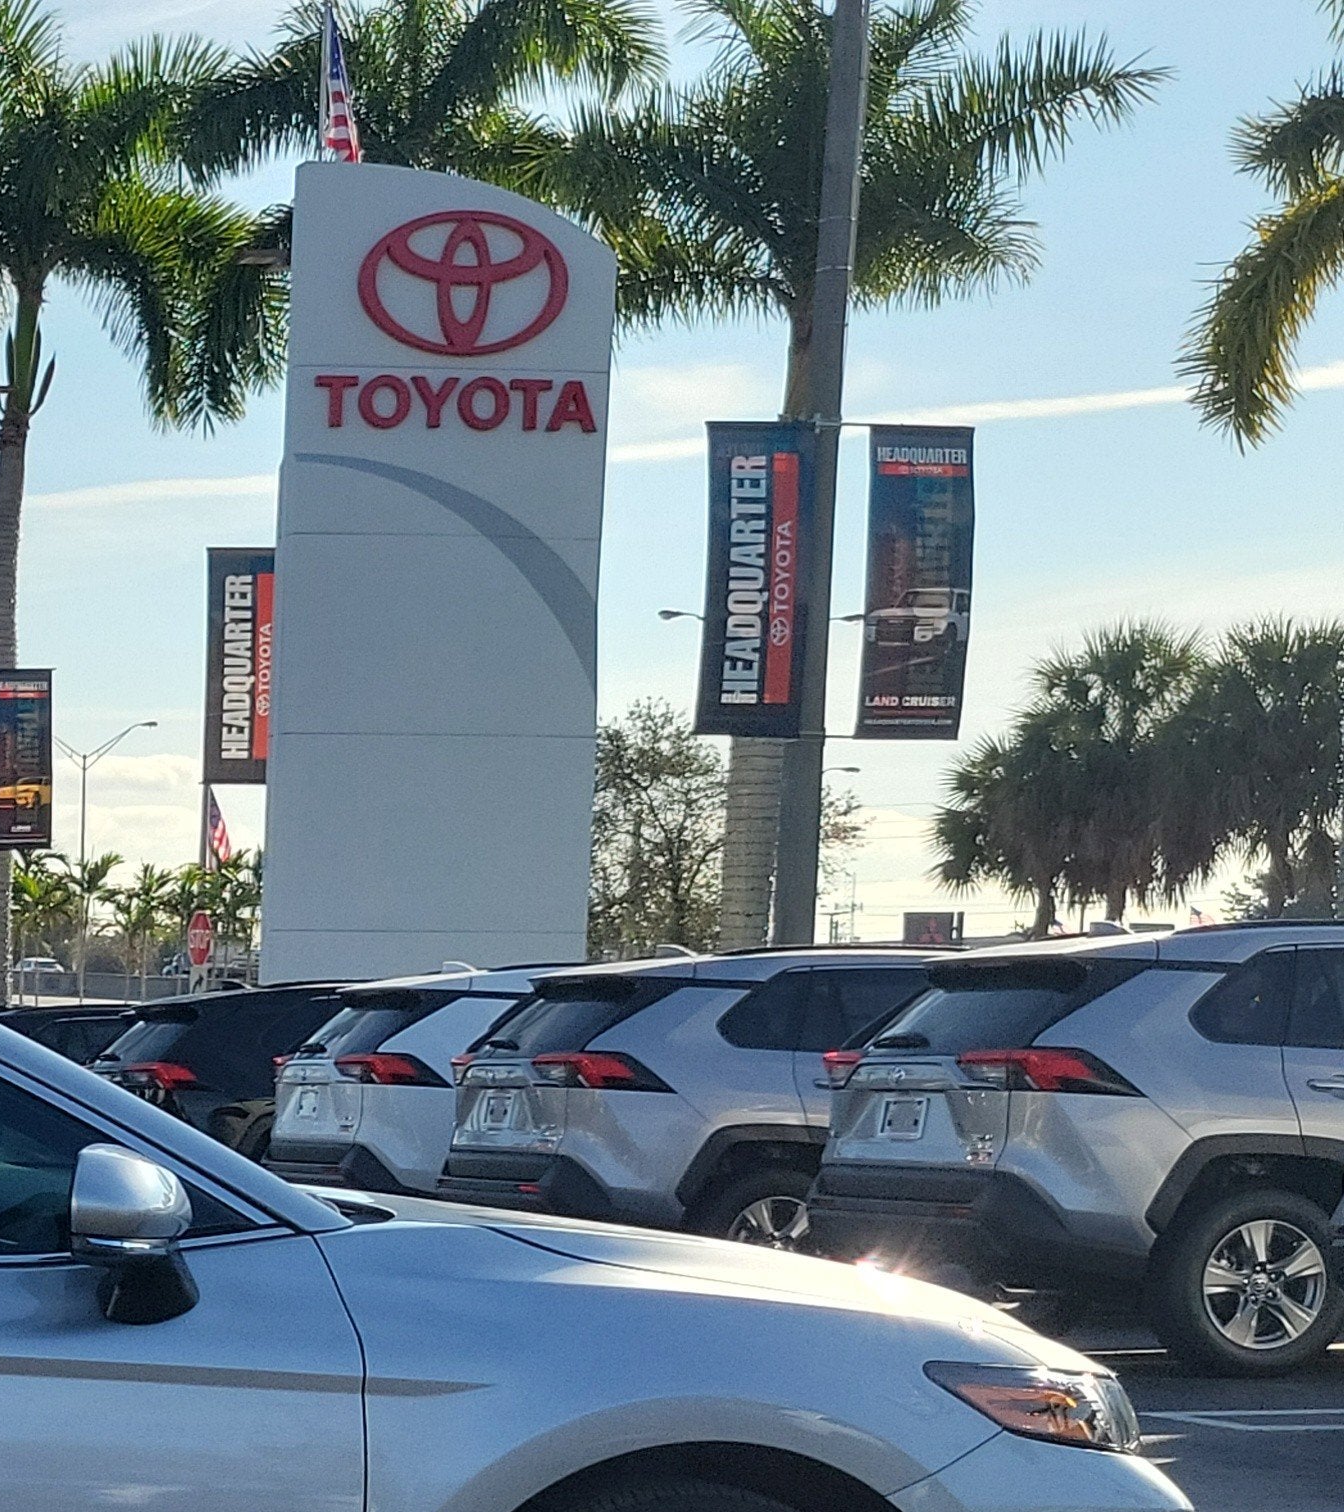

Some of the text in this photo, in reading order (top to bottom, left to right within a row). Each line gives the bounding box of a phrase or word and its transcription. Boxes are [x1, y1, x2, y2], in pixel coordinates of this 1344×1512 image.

[315, 375, 597, 433] TOYOTA
[877, 446, 968, 465] HEADQUARTER
[720, 453, 769, 705] HEADQUARTER
[772, 520, 793, 613] TOYOTA
[221, 574, 256, 760] HEADQUARTER
[257, 623, 272, 692] TOYOTA
[865, 696, 957, 707] LAND CRUISER
